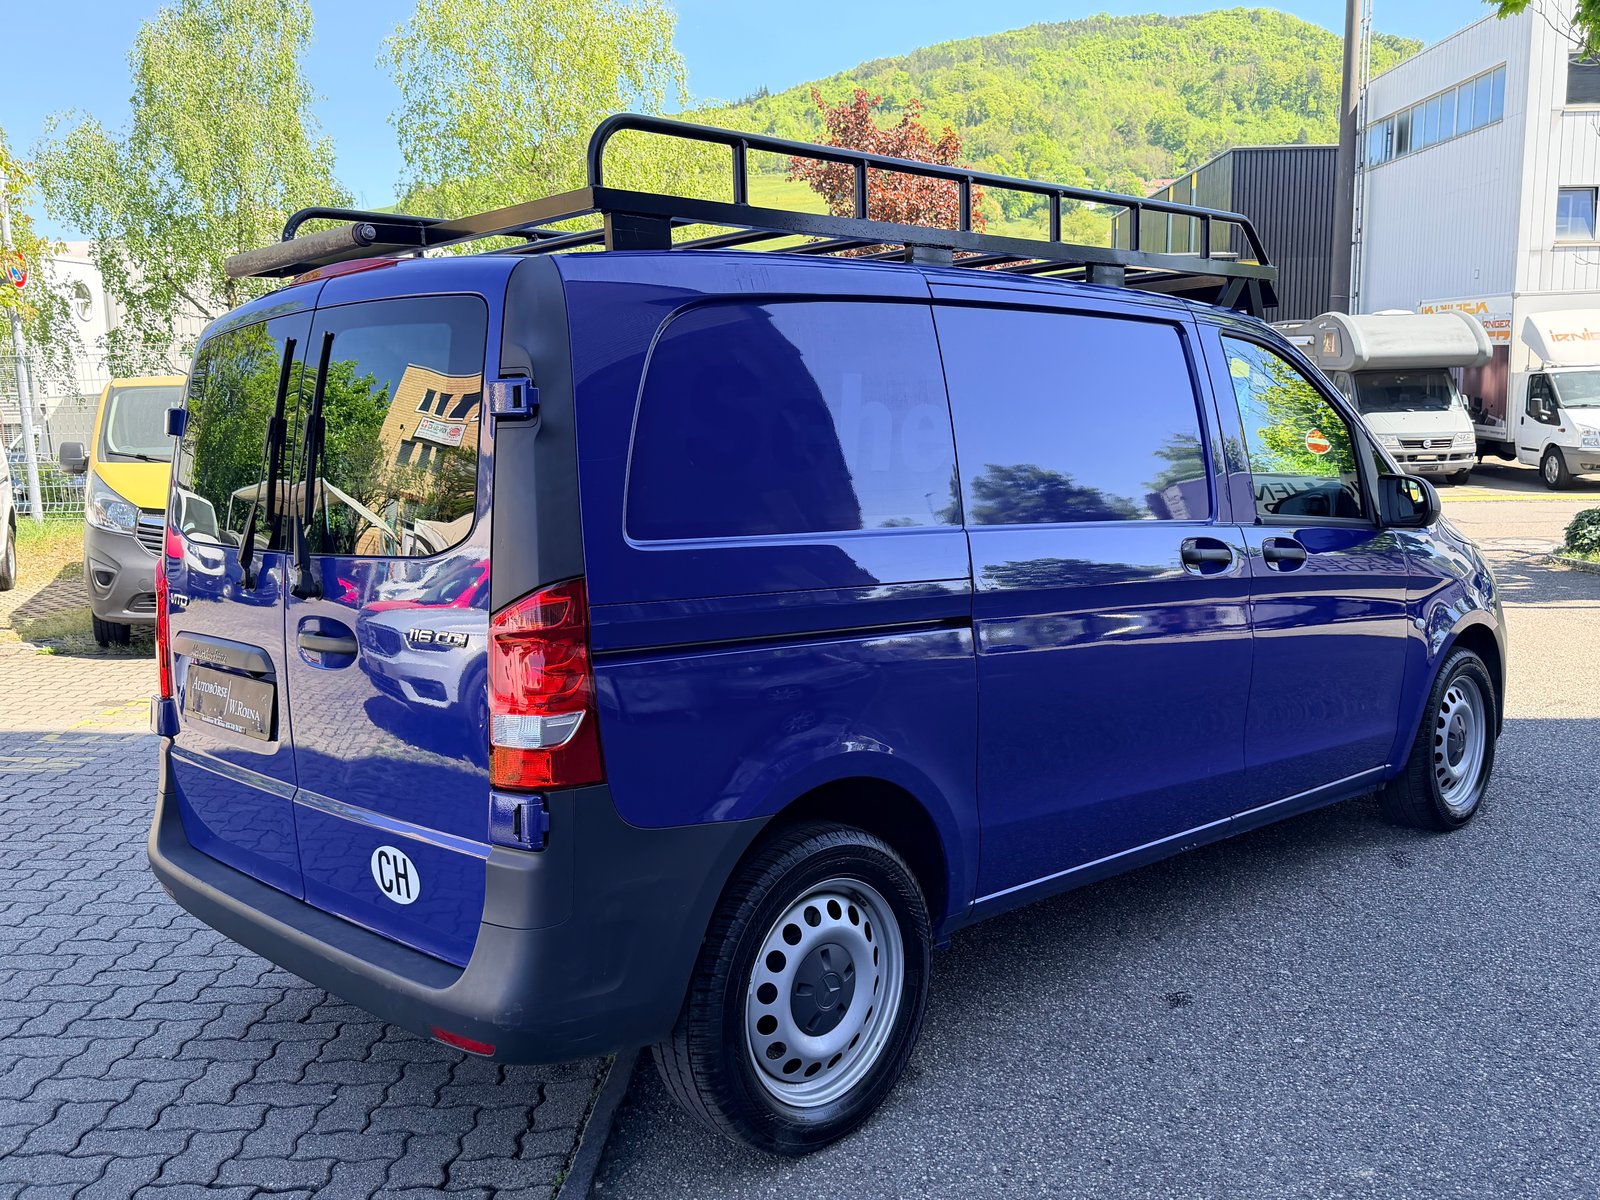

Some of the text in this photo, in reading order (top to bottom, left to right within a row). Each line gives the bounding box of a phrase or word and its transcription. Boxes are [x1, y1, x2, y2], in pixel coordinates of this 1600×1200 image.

[409, 628, 469, 648] 116 CDI
[378, 850, 411, 899] CH
